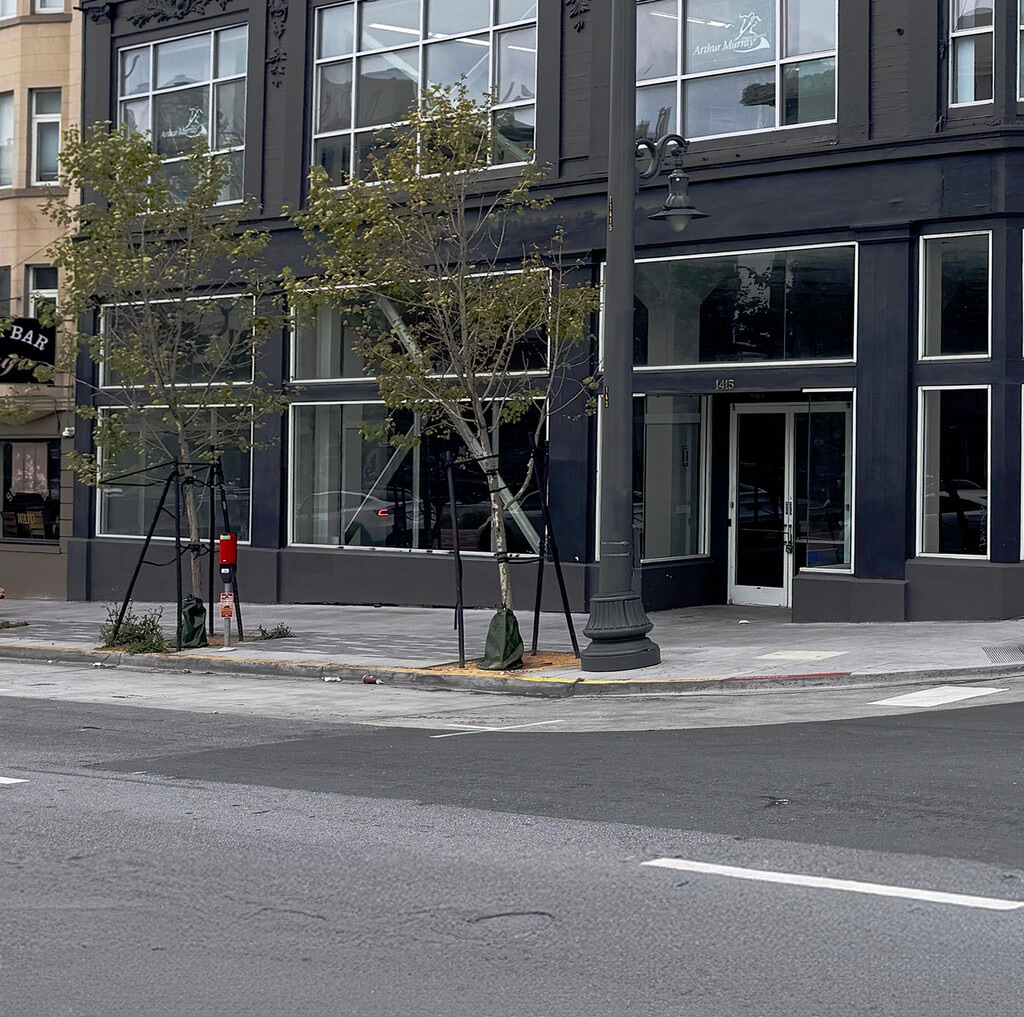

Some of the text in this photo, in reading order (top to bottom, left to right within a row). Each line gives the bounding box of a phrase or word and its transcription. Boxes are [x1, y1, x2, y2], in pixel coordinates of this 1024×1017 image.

[693, 39, 754, 56] Arthur Murray
[9, 325, 49, 351] BAR
[715, 379, 735, 390] 1415
